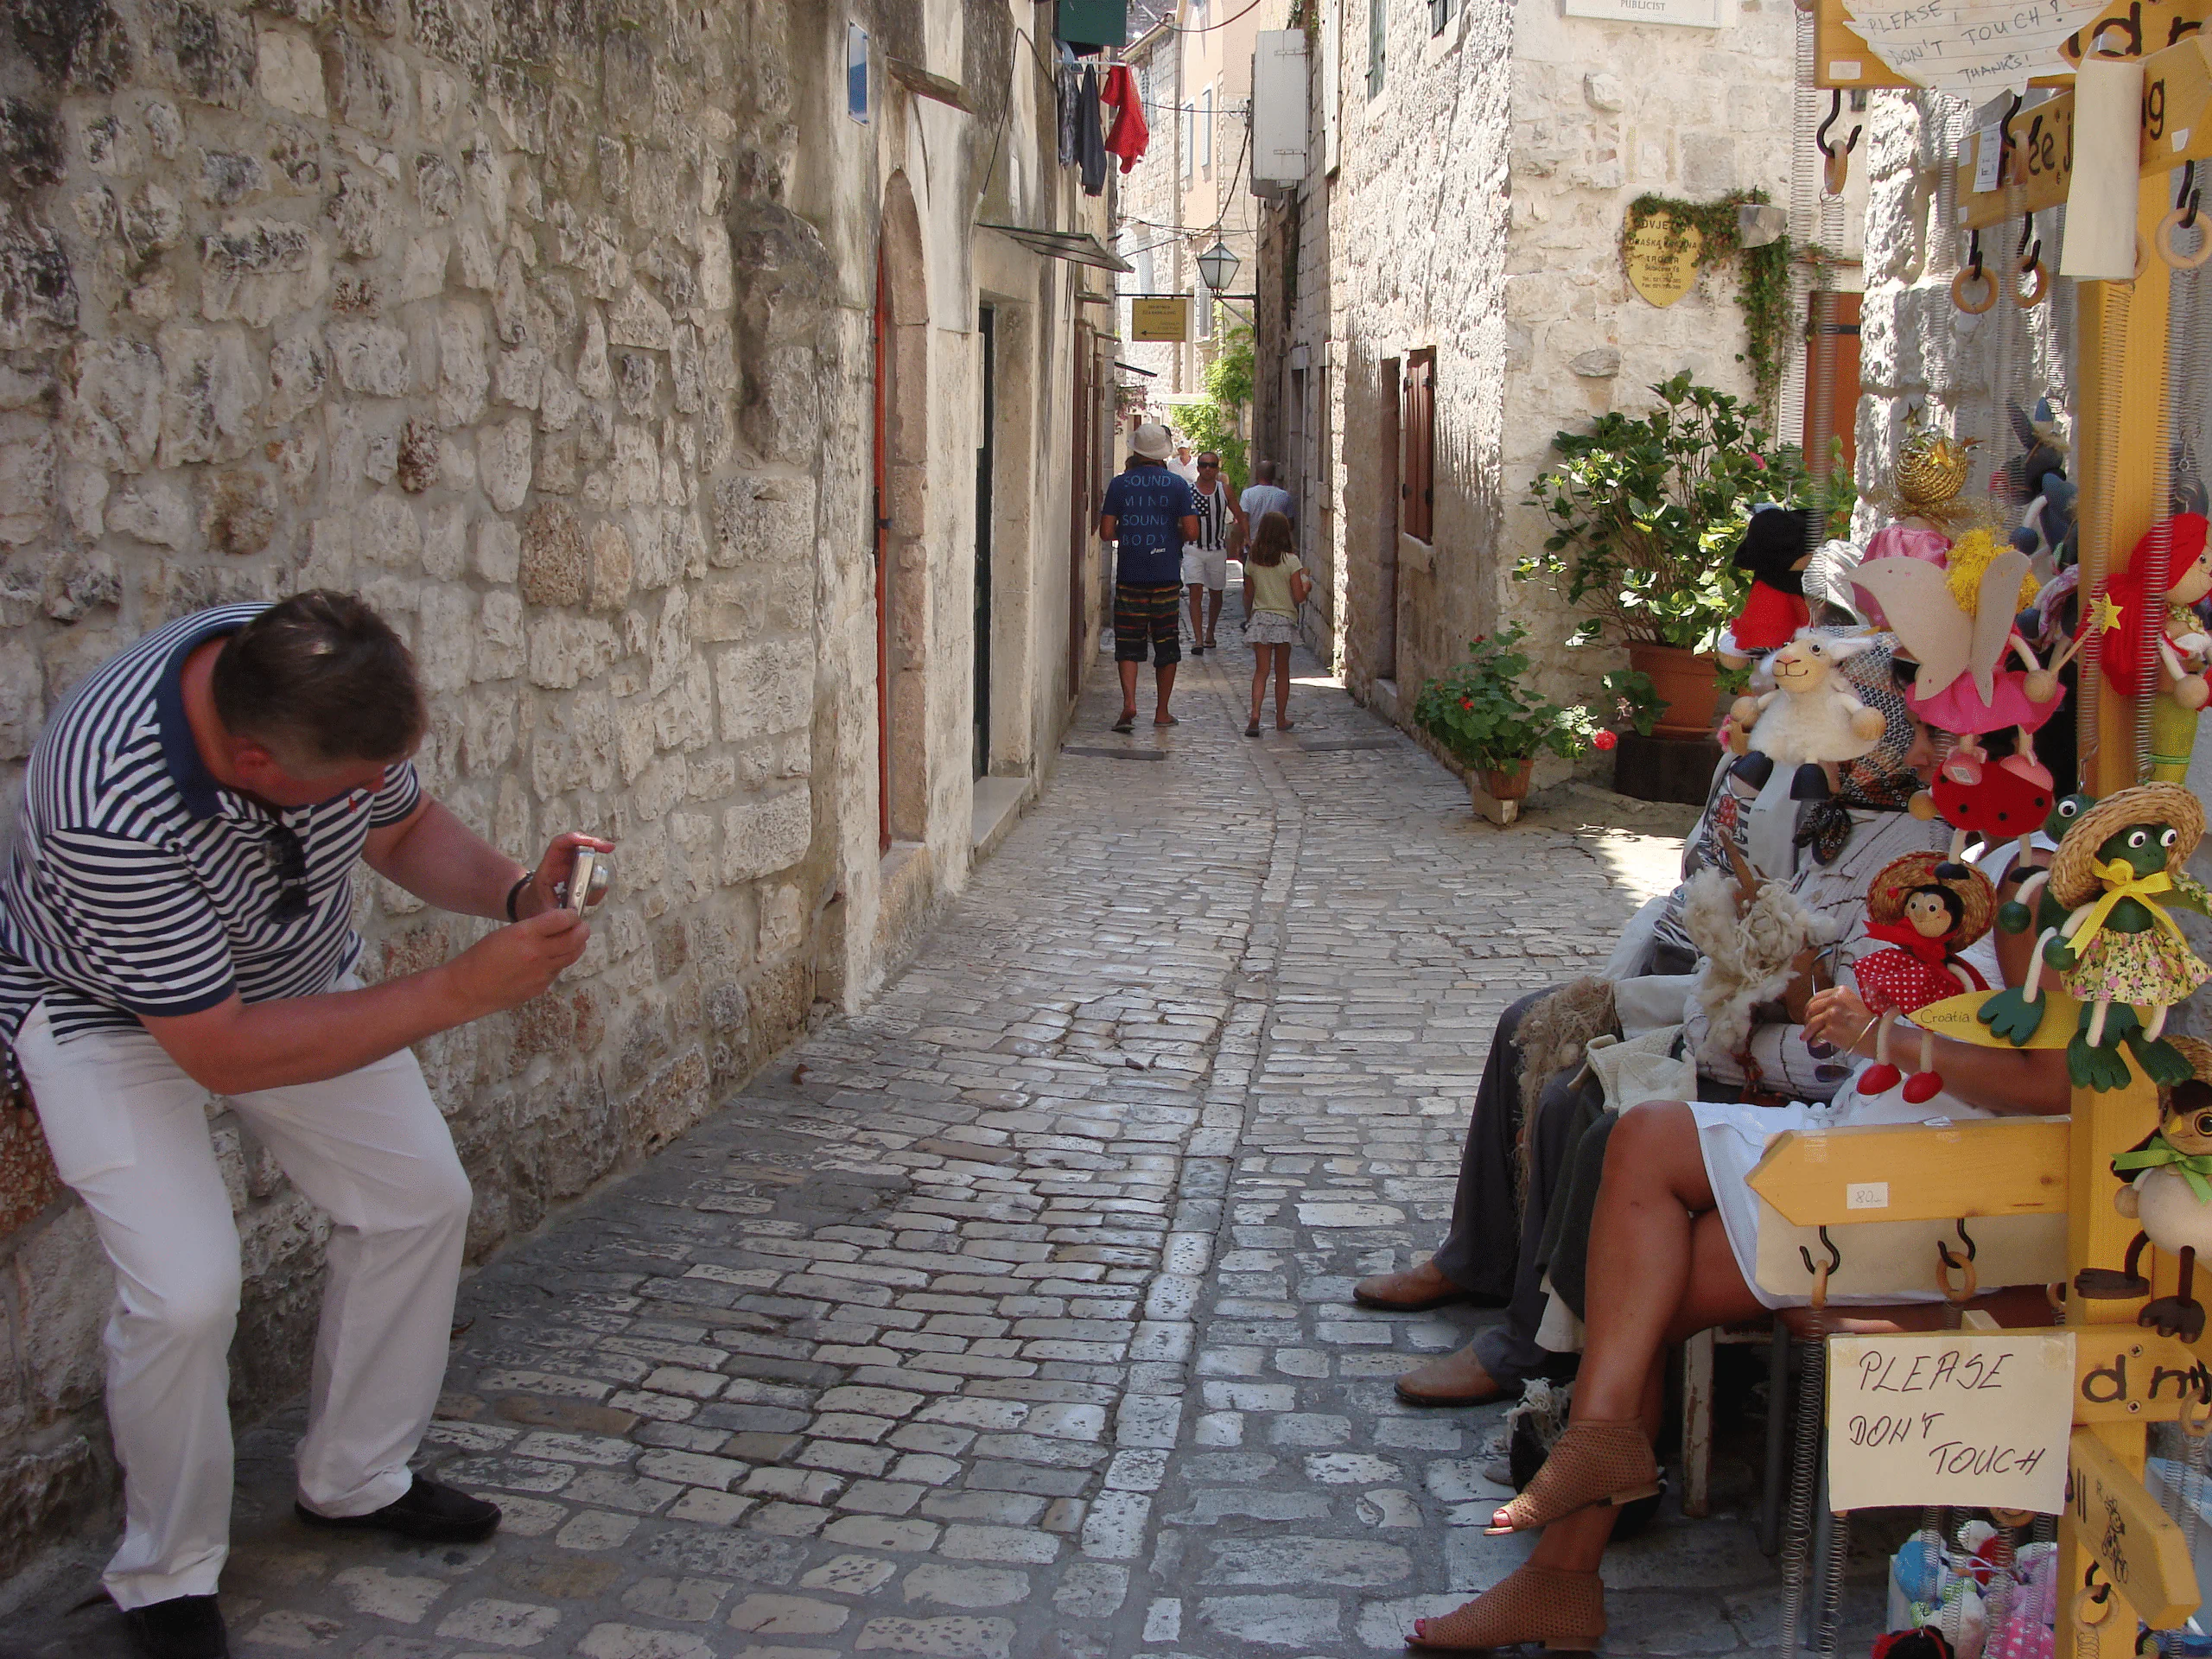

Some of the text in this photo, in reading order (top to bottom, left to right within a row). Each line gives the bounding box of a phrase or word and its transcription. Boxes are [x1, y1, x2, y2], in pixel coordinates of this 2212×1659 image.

[1620, 0, 1666, 10] PUBLICIST
[1890, 39, 1943, 66] DON'T
[1957, 54, 2031, 84] THANKS!
[1124, 475, 1171, 487] SOUND
[1125, 495, 1168, 506] MIND
[1122, 515, 1168, 525] SOUND
[1122, 534, 1166, 546] BODY
[1920, 1009, 1970, 1024] Croatia
[1859, 1351, 2014, 1392] PLEASE
[1849, 1412, 1944, 1446] DON'T
[1929, 1441, 2046, 1475] TOUCH
